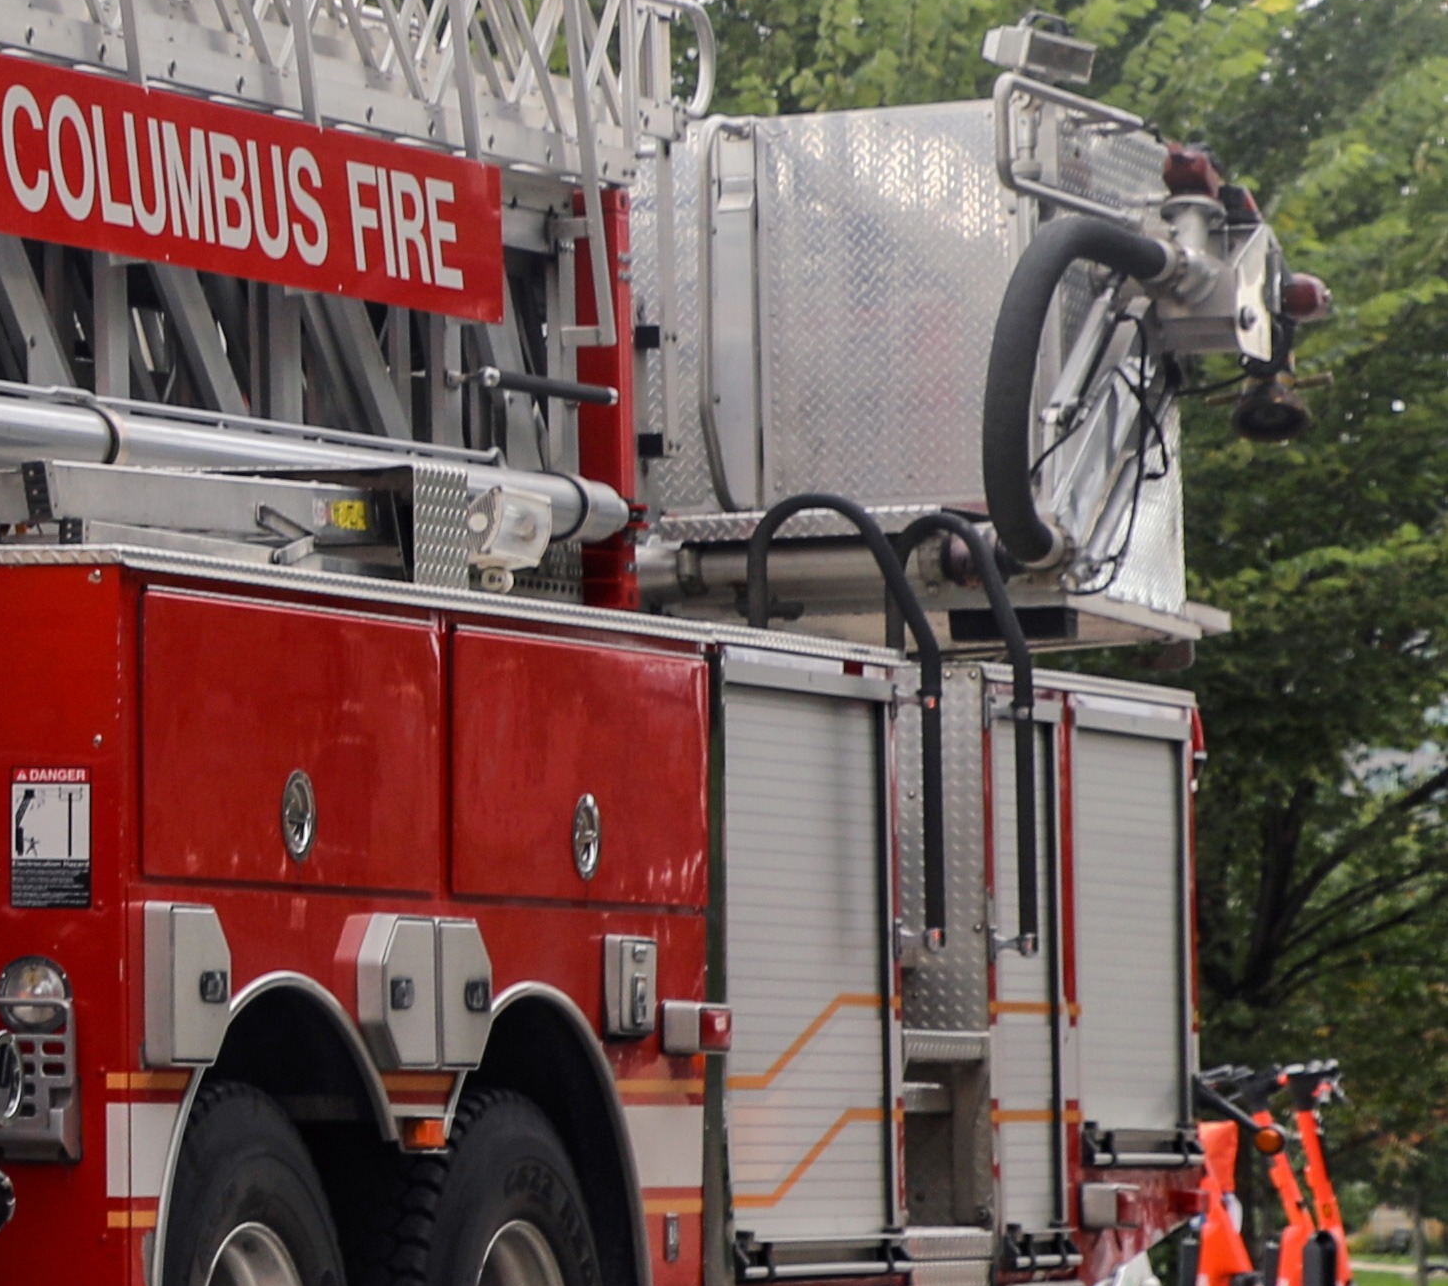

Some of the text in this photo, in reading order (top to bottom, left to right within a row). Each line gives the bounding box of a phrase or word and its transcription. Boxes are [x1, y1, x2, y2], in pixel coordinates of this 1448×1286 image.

[2, 84, 465, 290] COLUMBUS FIRE
[29, 768, 86, 781] DANGER
